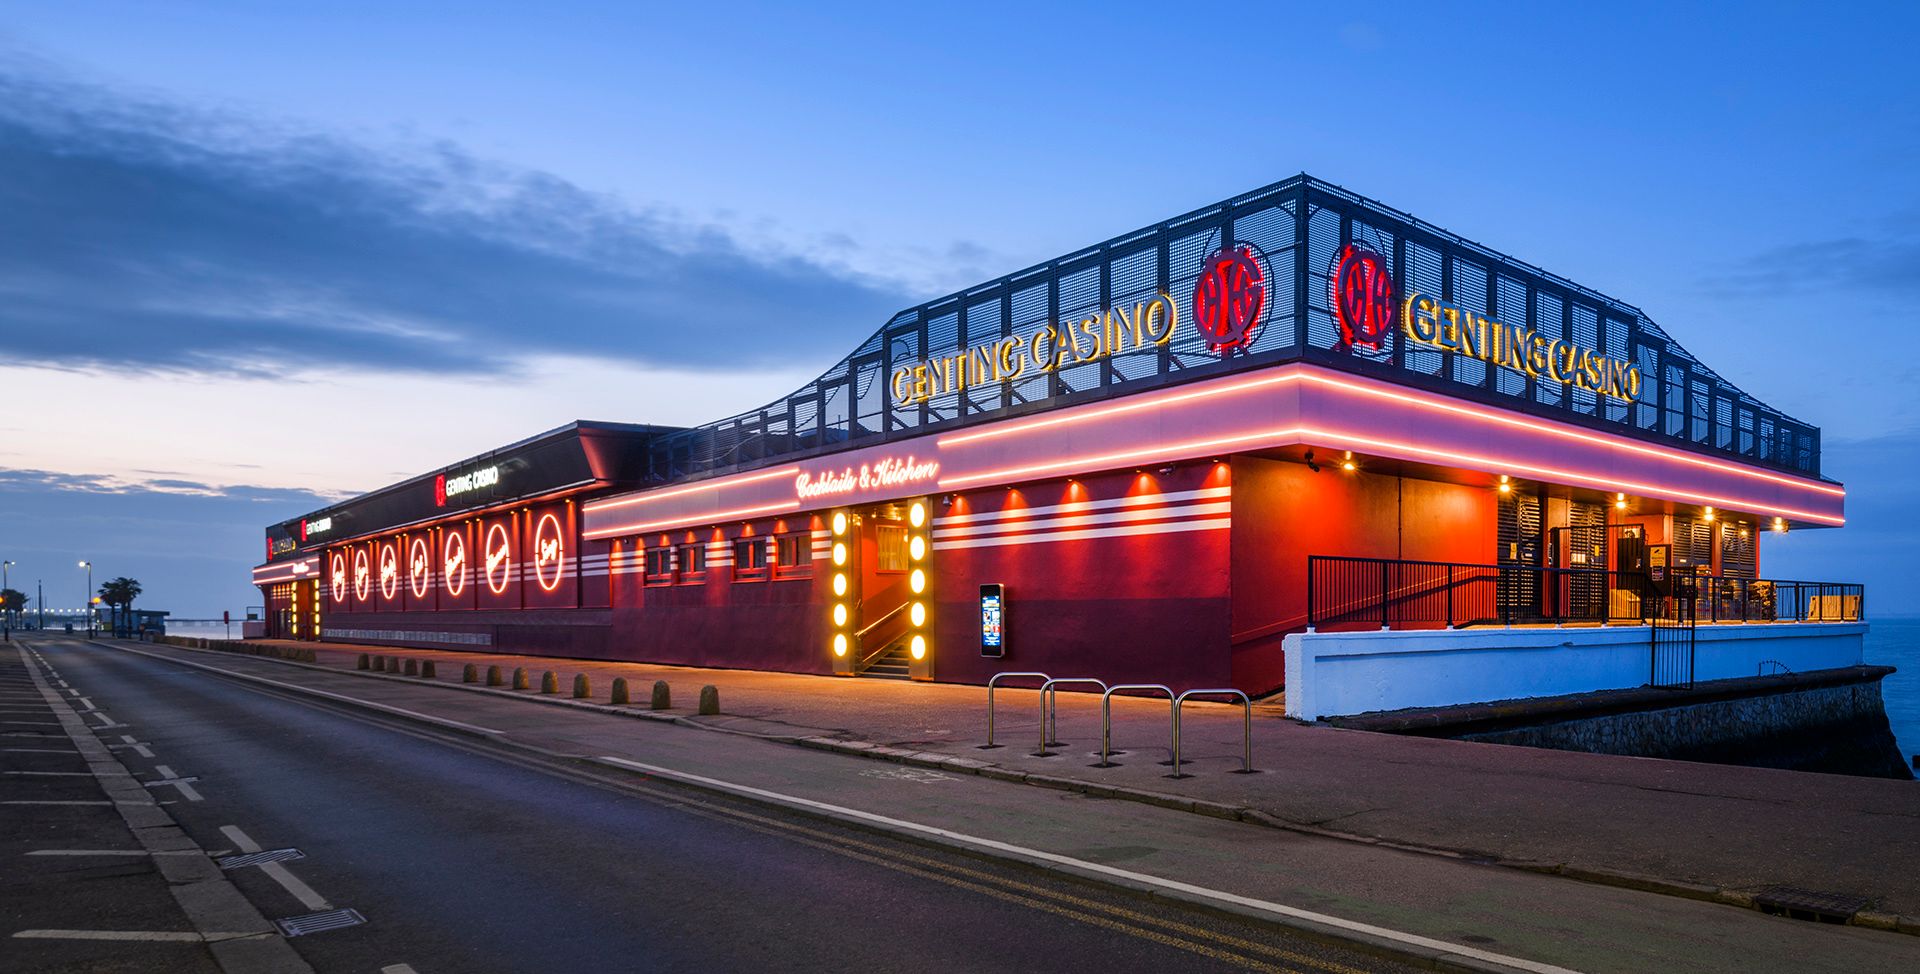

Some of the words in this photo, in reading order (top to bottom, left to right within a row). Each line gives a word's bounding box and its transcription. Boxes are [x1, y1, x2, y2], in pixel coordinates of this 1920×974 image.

[889, 335, 1025, 405] GENTING
[1030, 292, 1178, 372] CASINO
[1405, 293, 1548, 375] GENTING
[1549, 338, 1644, 402] CASINO
[795, 467, 857, 498] Cocktails
[859, 465, 870, 489] &
[871, 456, 939, 487] Kitchen
